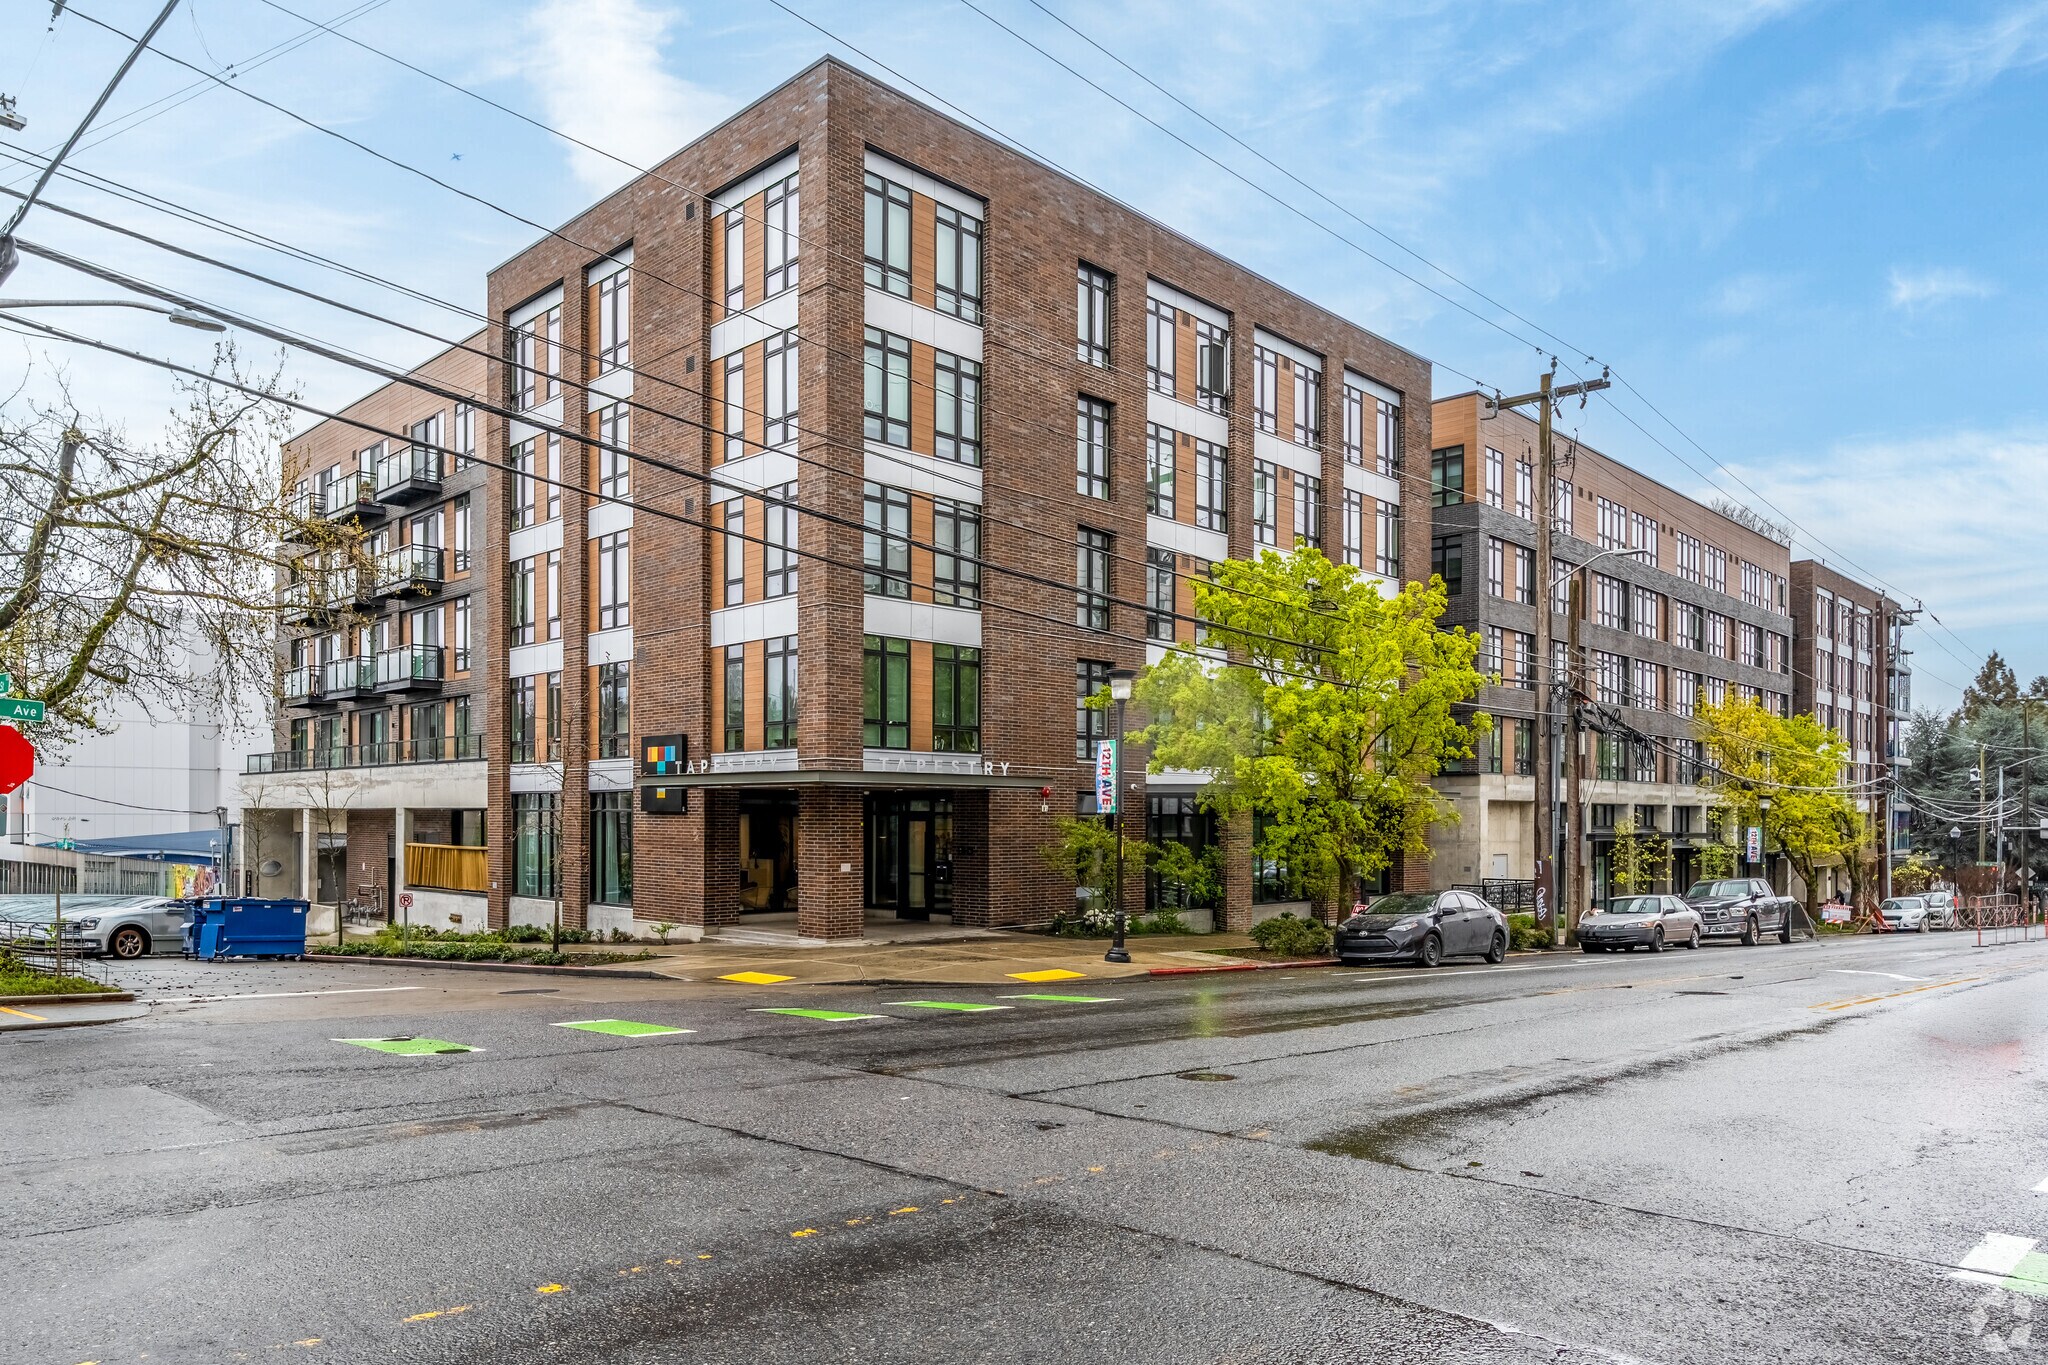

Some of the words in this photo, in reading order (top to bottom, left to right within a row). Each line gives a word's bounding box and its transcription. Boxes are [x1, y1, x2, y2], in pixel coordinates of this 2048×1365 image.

[13, 704, 37, 717] Ave
[675, 755, 778, 775] TAPESTRY
[879, 757, 1010, 776] TAPESTRY
[1101, 747, 1112, 776] 12TH
[1101, 779, 1113, 806] AVE
